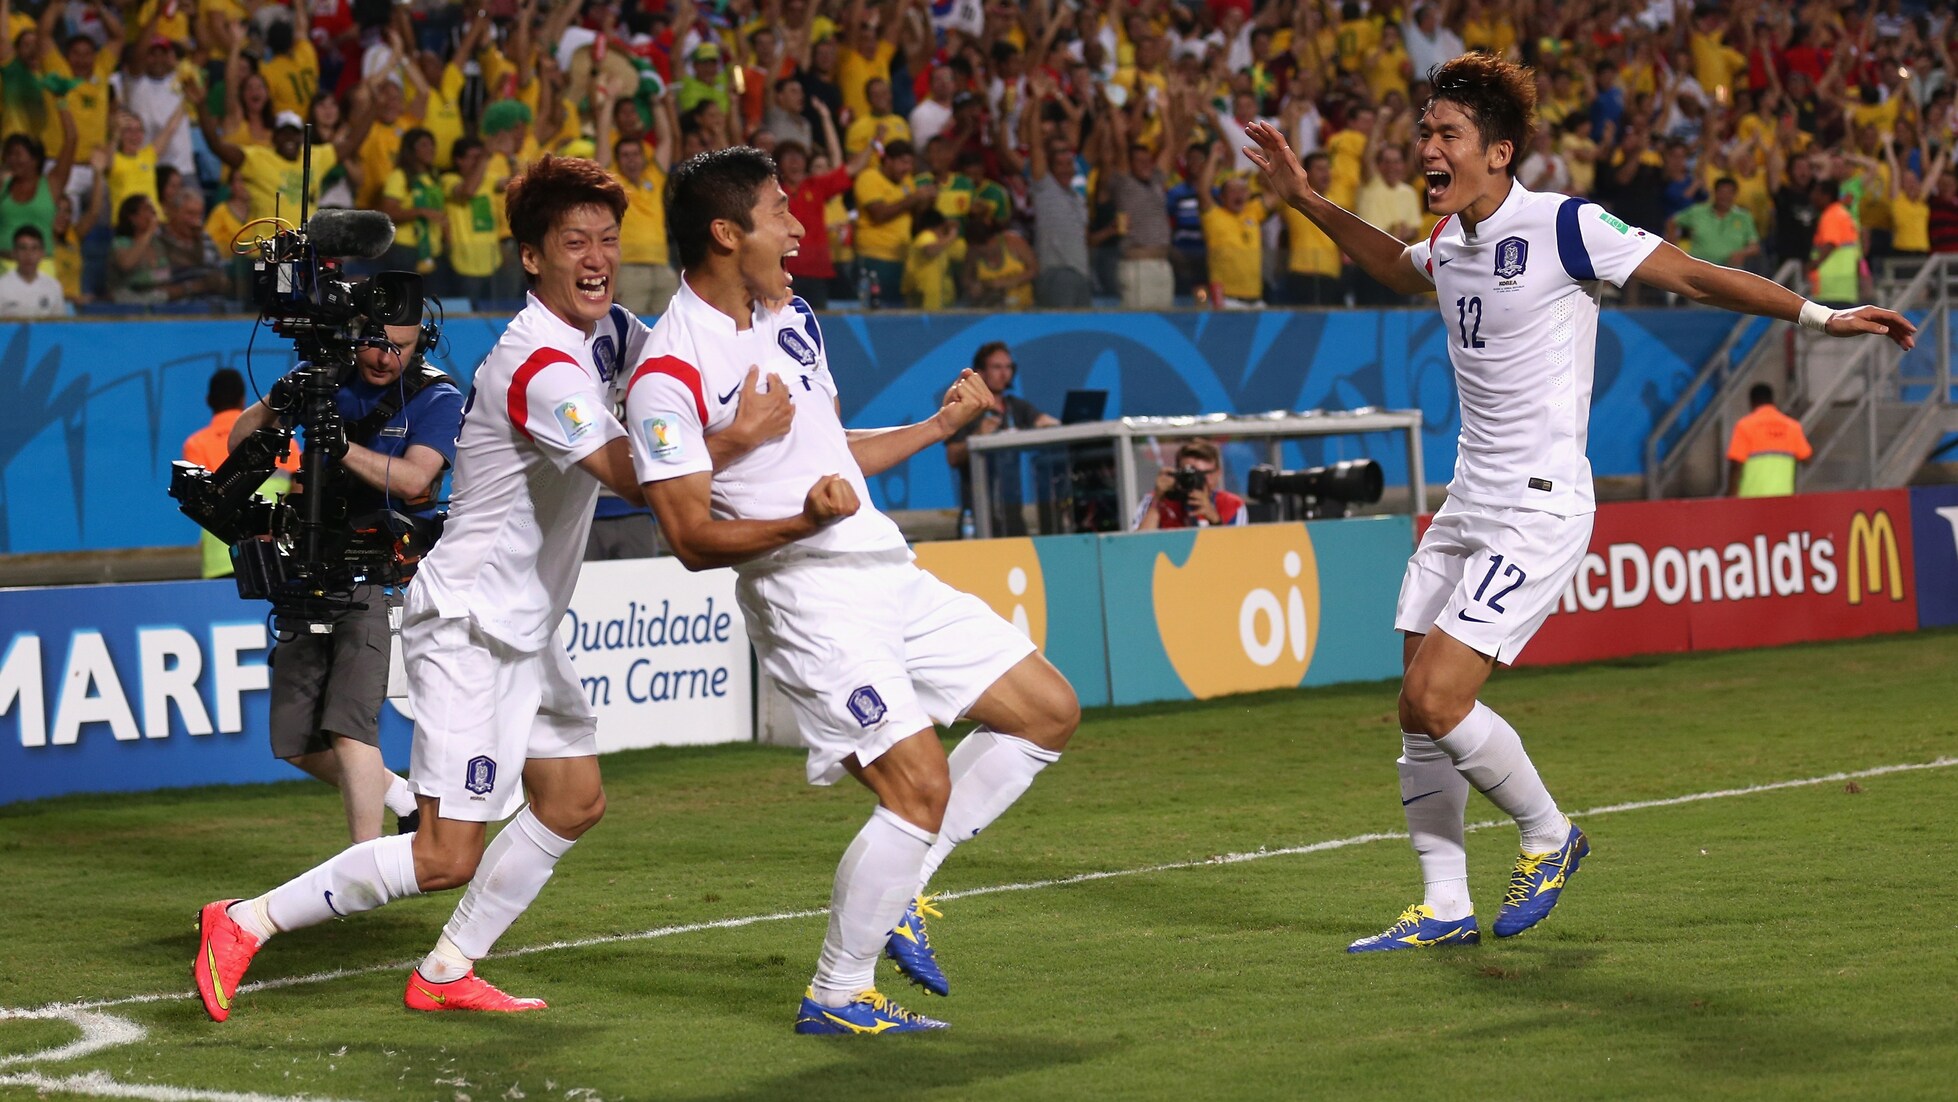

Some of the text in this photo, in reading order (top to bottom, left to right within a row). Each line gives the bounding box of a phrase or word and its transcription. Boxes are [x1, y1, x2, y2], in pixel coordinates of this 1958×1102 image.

[1456, 296, 1486, 349] 12
[1238, 550, 1307, 666] oi
[1473, 554, 1527, 614] 12
[580, 658, 728, 706] m Carne
